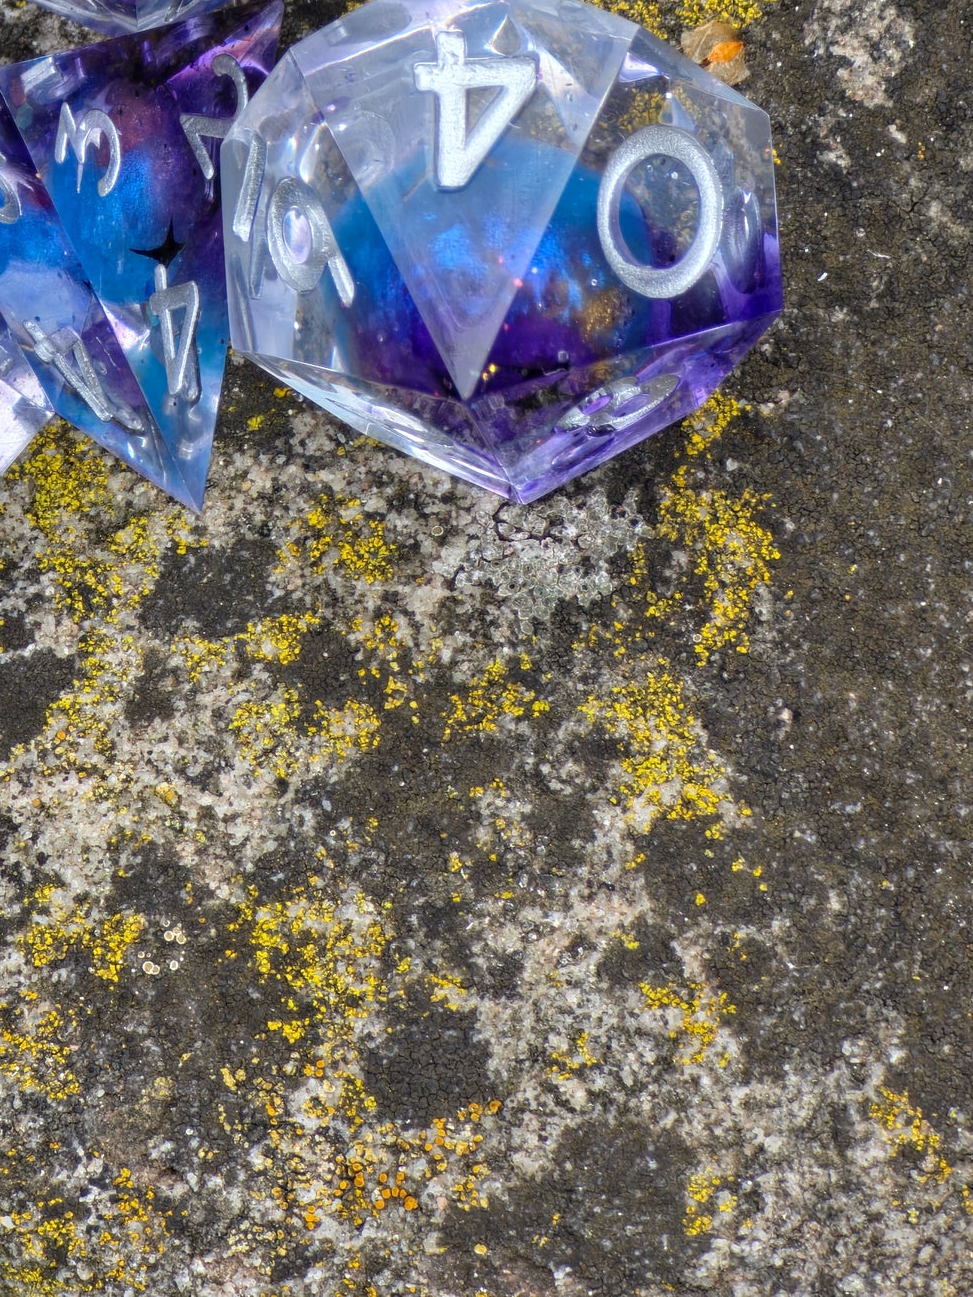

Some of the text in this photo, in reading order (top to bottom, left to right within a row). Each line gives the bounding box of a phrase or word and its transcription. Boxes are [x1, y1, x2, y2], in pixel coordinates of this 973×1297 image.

[54, 101, 122, 197] 3
[412, 29, 541, 191] 4
[596, 123, 724, 300] 0
[148, 263, 201, 396] 4
